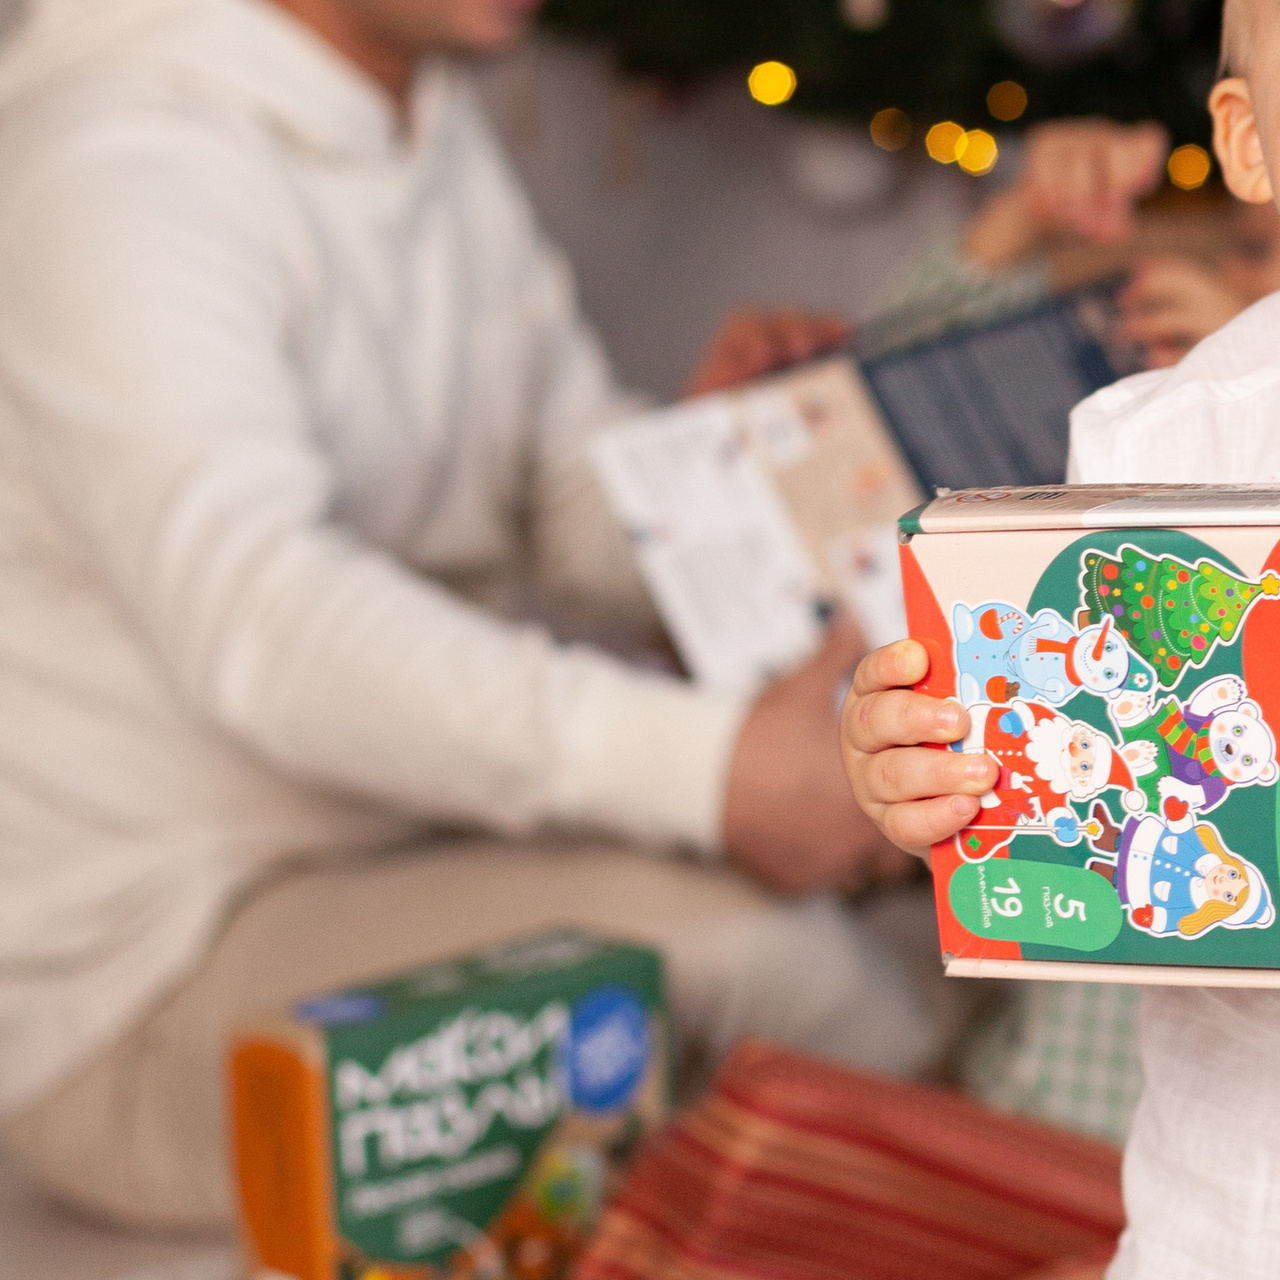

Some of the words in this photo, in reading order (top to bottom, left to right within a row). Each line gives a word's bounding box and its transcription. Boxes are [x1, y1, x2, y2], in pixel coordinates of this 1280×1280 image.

[976, 864, 993, 929] элементов
[990, 876, 1024, 918] 19
[1041, 886, 1054, 929] пазлов
[1053, 892, 1087, 922] 5
